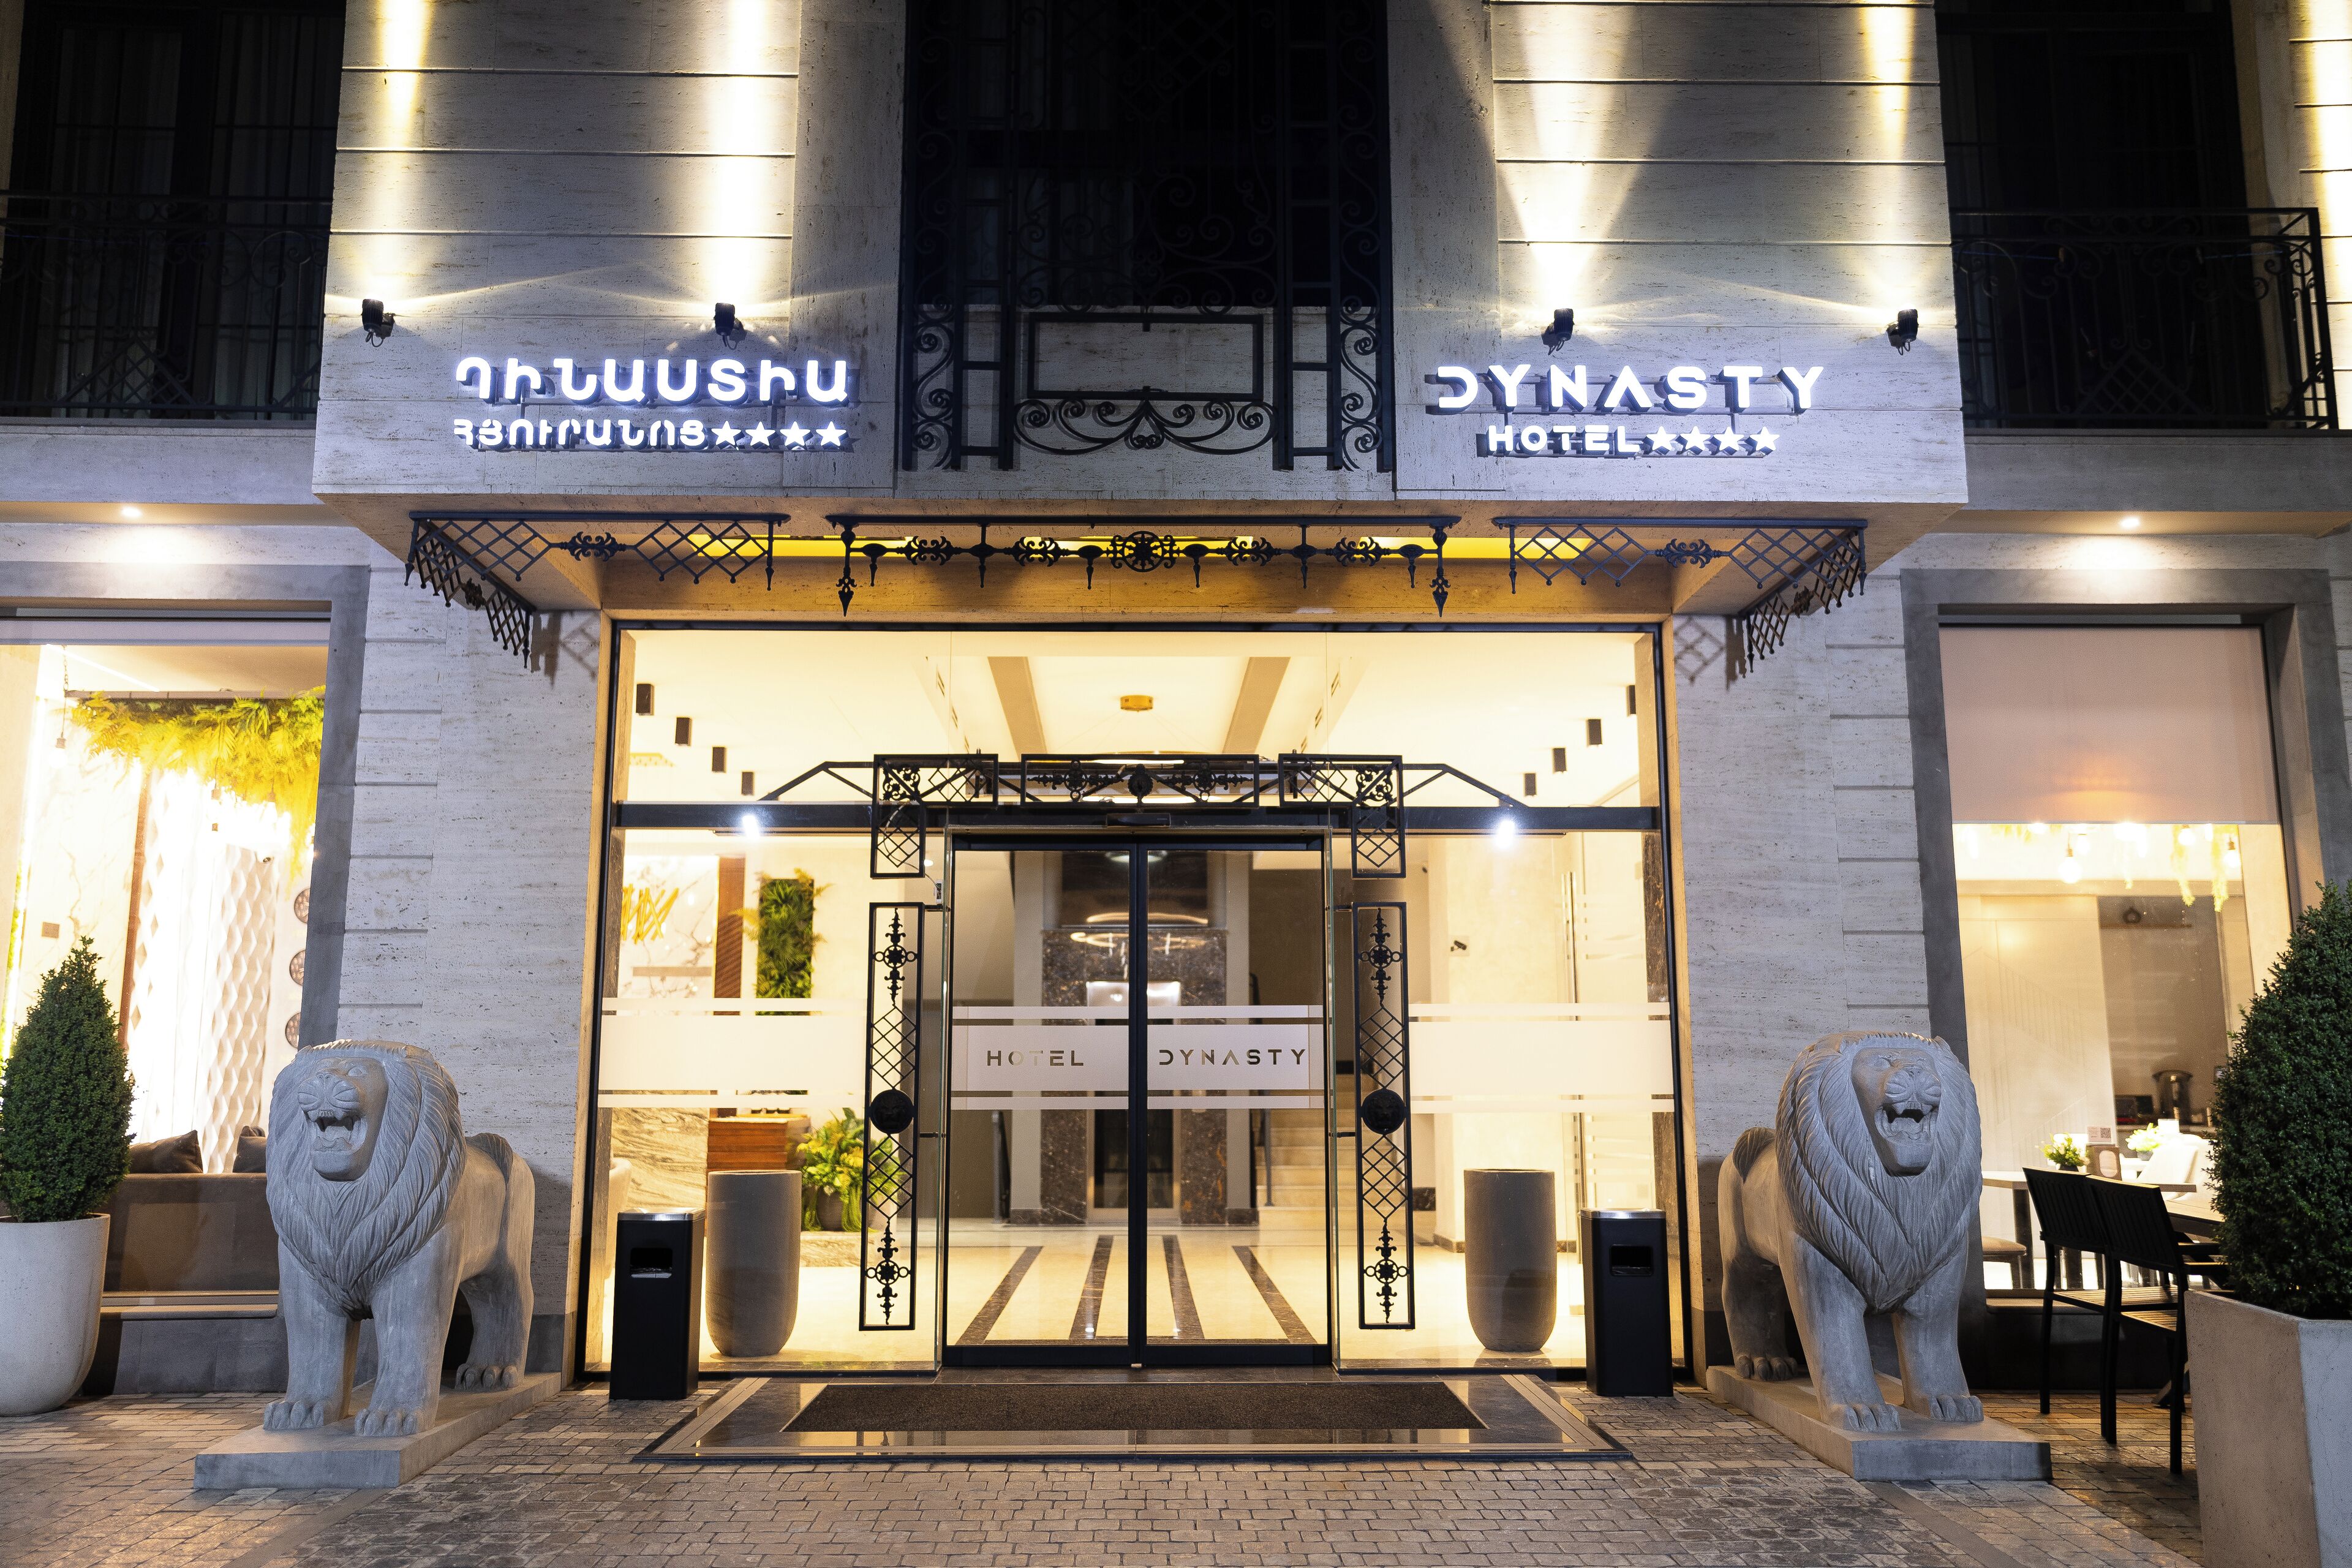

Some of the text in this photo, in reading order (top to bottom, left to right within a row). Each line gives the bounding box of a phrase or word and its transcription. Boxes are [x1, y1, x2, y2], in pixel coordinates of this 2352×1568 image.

[1437, 364, 1825, 409] DYNASTY
[453, 418, 706, 446] ՀՅՈՒՐԱՆՈՑ
[1488, 424, 1641, 453] HOTEL
[987, 1049, 1306, 1066] HOTEL DYNASTY
